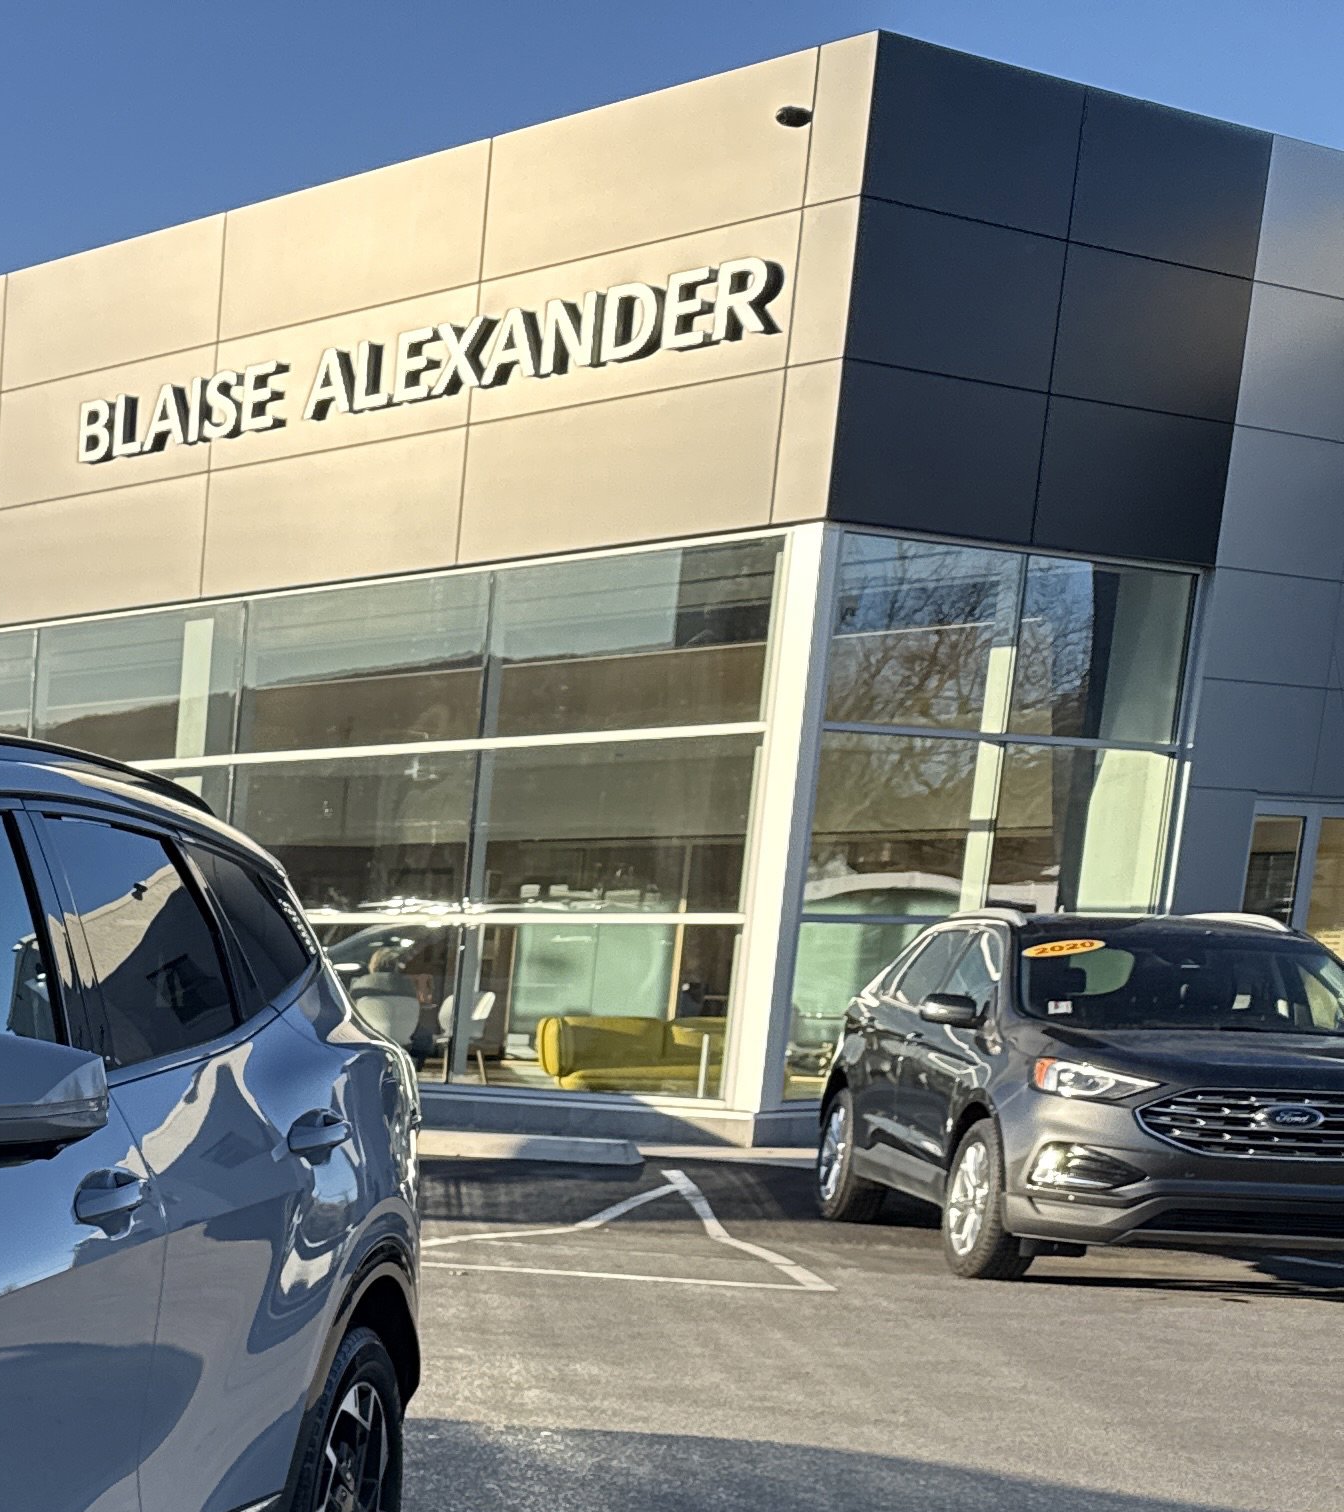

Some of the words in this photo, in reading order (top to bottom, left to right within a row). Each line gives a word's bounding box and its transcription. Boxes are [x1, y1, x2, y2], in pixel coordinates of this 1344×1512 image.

[78, 361, 291, 465] BLAISE
[303, 256, 785, 421] ALEXANDER
[1034, 941, 1095, 955] 2020
[1275, 1111, 1310, 1123] Ford
